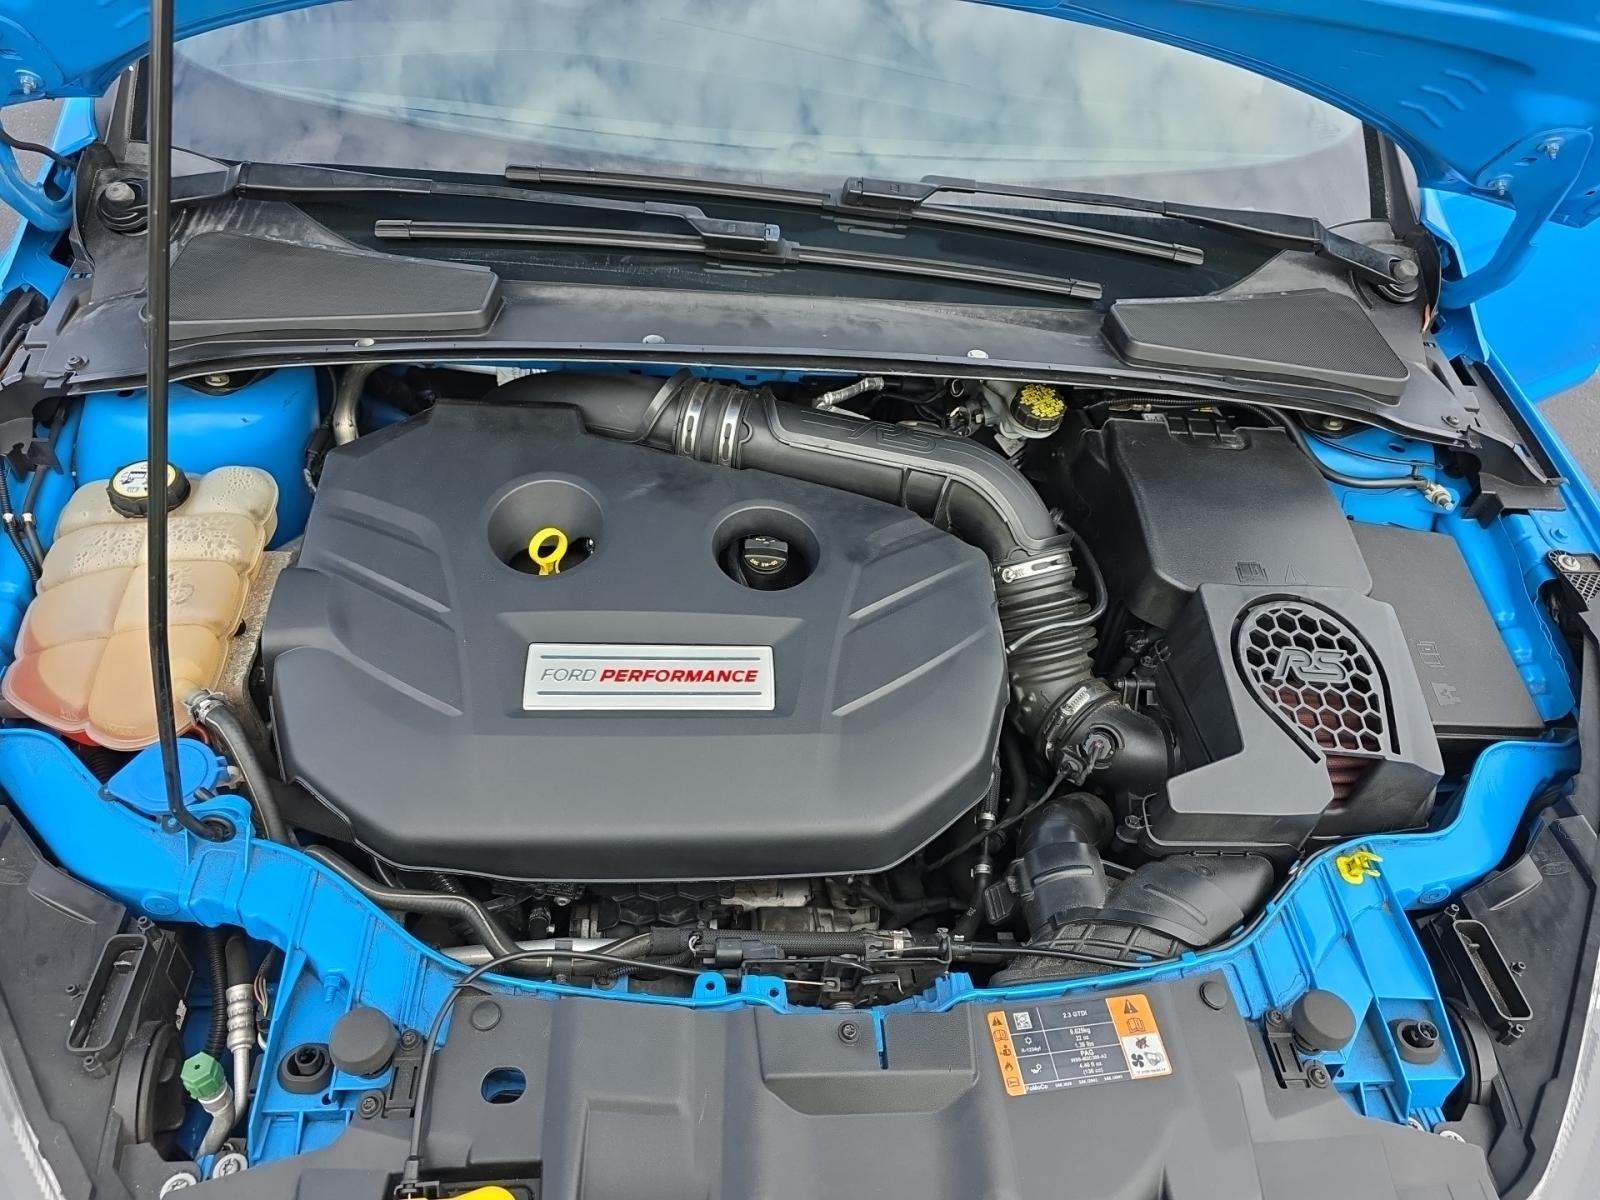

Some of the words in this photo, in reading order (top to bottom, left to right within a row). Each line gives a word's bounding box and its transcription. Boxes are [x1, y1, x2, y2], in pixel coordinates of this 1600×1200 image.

[1272, 646, 1347, 684] RS
[540, 667, 597, 682] FORD
[599, 668, 759, 683] PERFORMANCE
[1080, 1049, 1095, 1057] PAG
